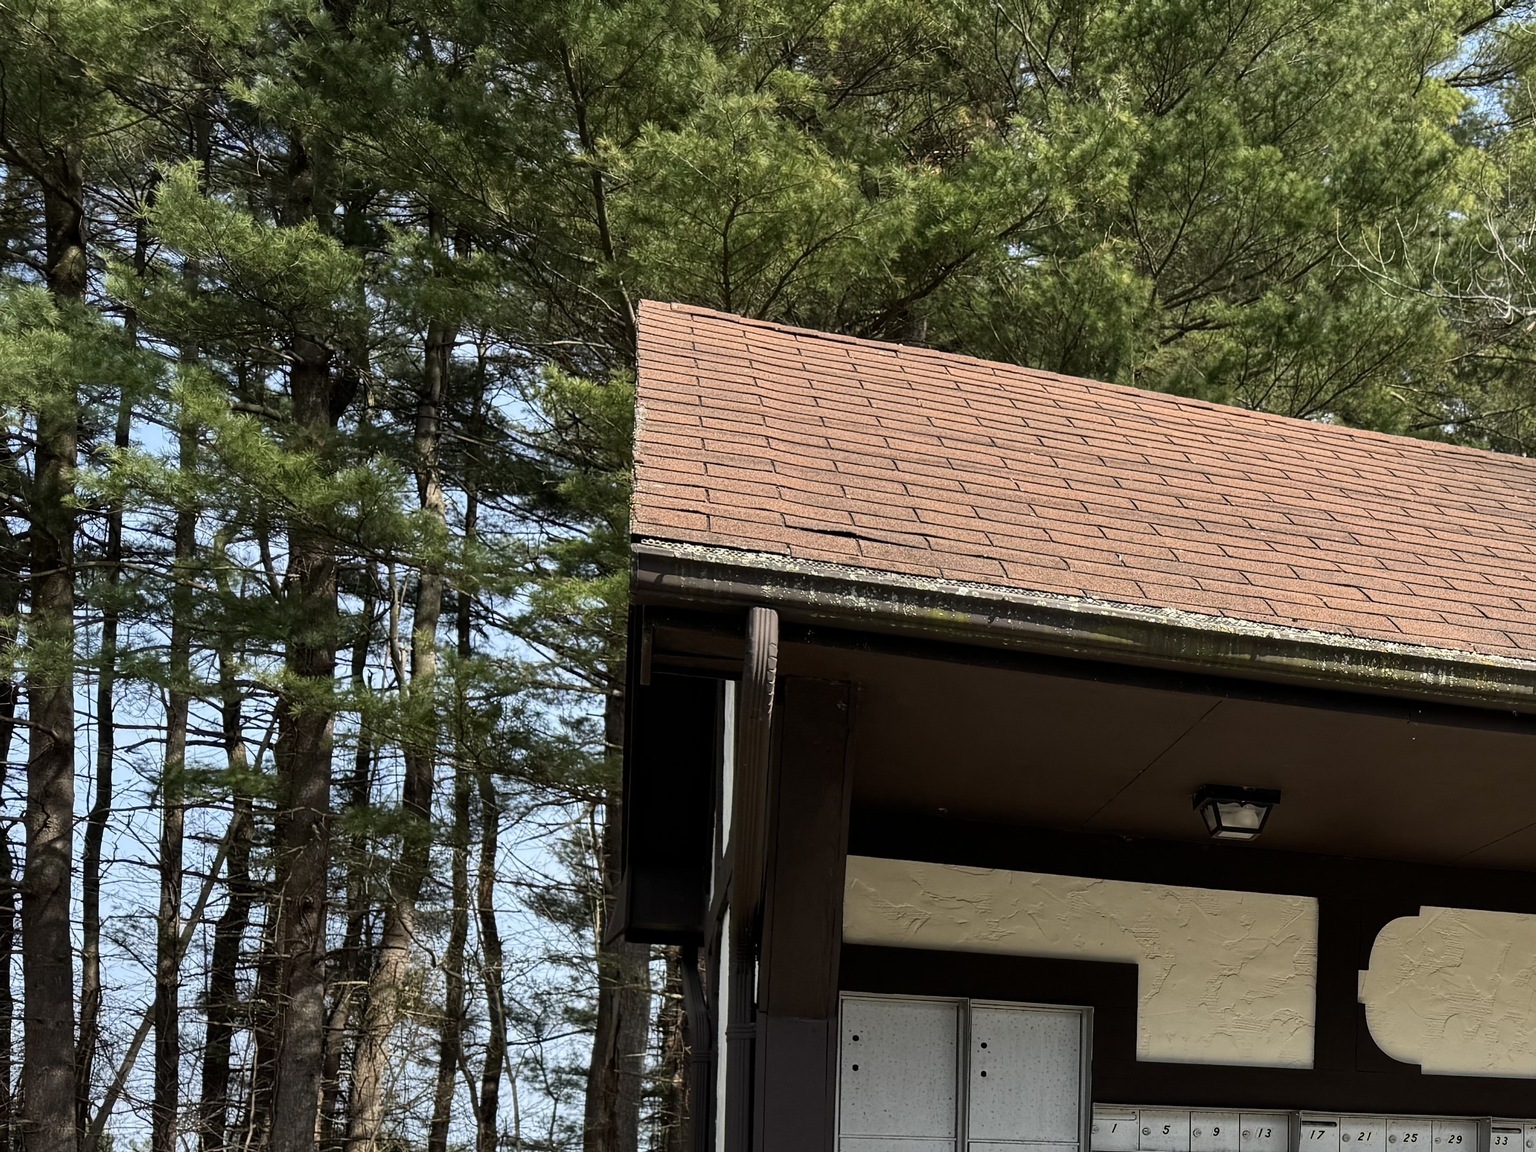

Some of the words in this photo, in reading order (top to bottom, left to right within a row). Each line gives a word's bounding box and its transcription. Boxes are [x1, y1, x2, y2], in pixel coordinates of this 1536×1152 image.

[1161, 1124, 1172, 1136] 5
[1212, 1126, 1221, 1137] 9
[1257, 1127, 1273, 1139] 13
[1309, 1129, 1326, 1140] 17
[1357, 1131, 1372, 1142] 21
[1402, 1132, 1419, 1144] 25
[1447, 1134, 1463, 1145] 29
[1494, 1135, 1509, 1146] 33
